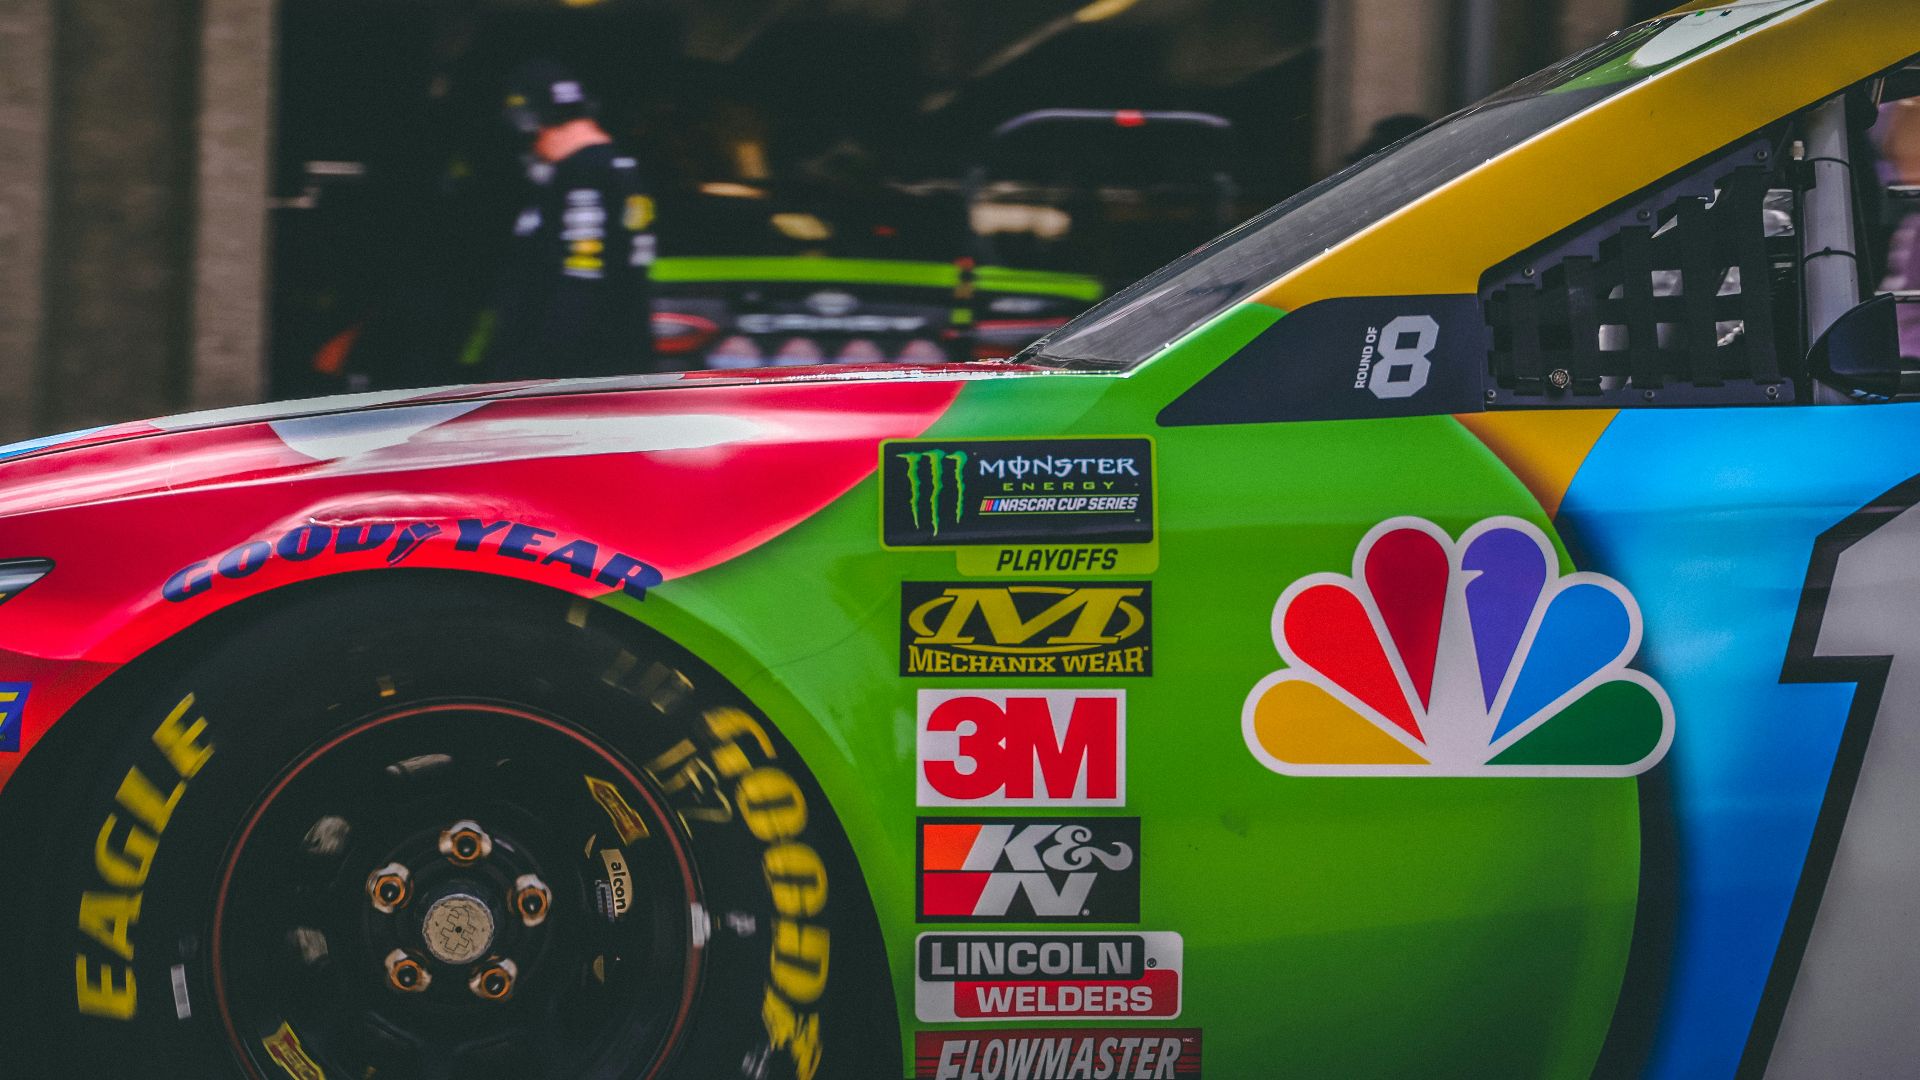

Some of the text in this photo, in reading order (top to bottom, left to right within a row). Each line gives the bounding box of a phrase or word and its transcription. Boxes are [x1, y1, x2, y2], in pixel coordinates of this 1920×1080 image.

[1354, 326, 1378, 389] ROUND OF
[1368, 314, 1439, 399] 8
[979, 455, 1140, 479] MONSTER
[1003, 481, 1114, 491] ENERGY
[998, 496, 1138, 512] NASCAR CUP SERIES
[996, 548, 1118, 571] PLAYOFFS
[908, 645, 1145, 673] MECHANIX WEAR
[923, 696, 1118, 800] 3M
[76, 692, 215, 1021] EAGLE
[610, 861, 627, 910] alcon
[931, 942, 1132, 975] LINCOLN
[976, 985, 1153, 1012] WELDERS
[934, 1037, 1183, 1080] FLOWMASTER
